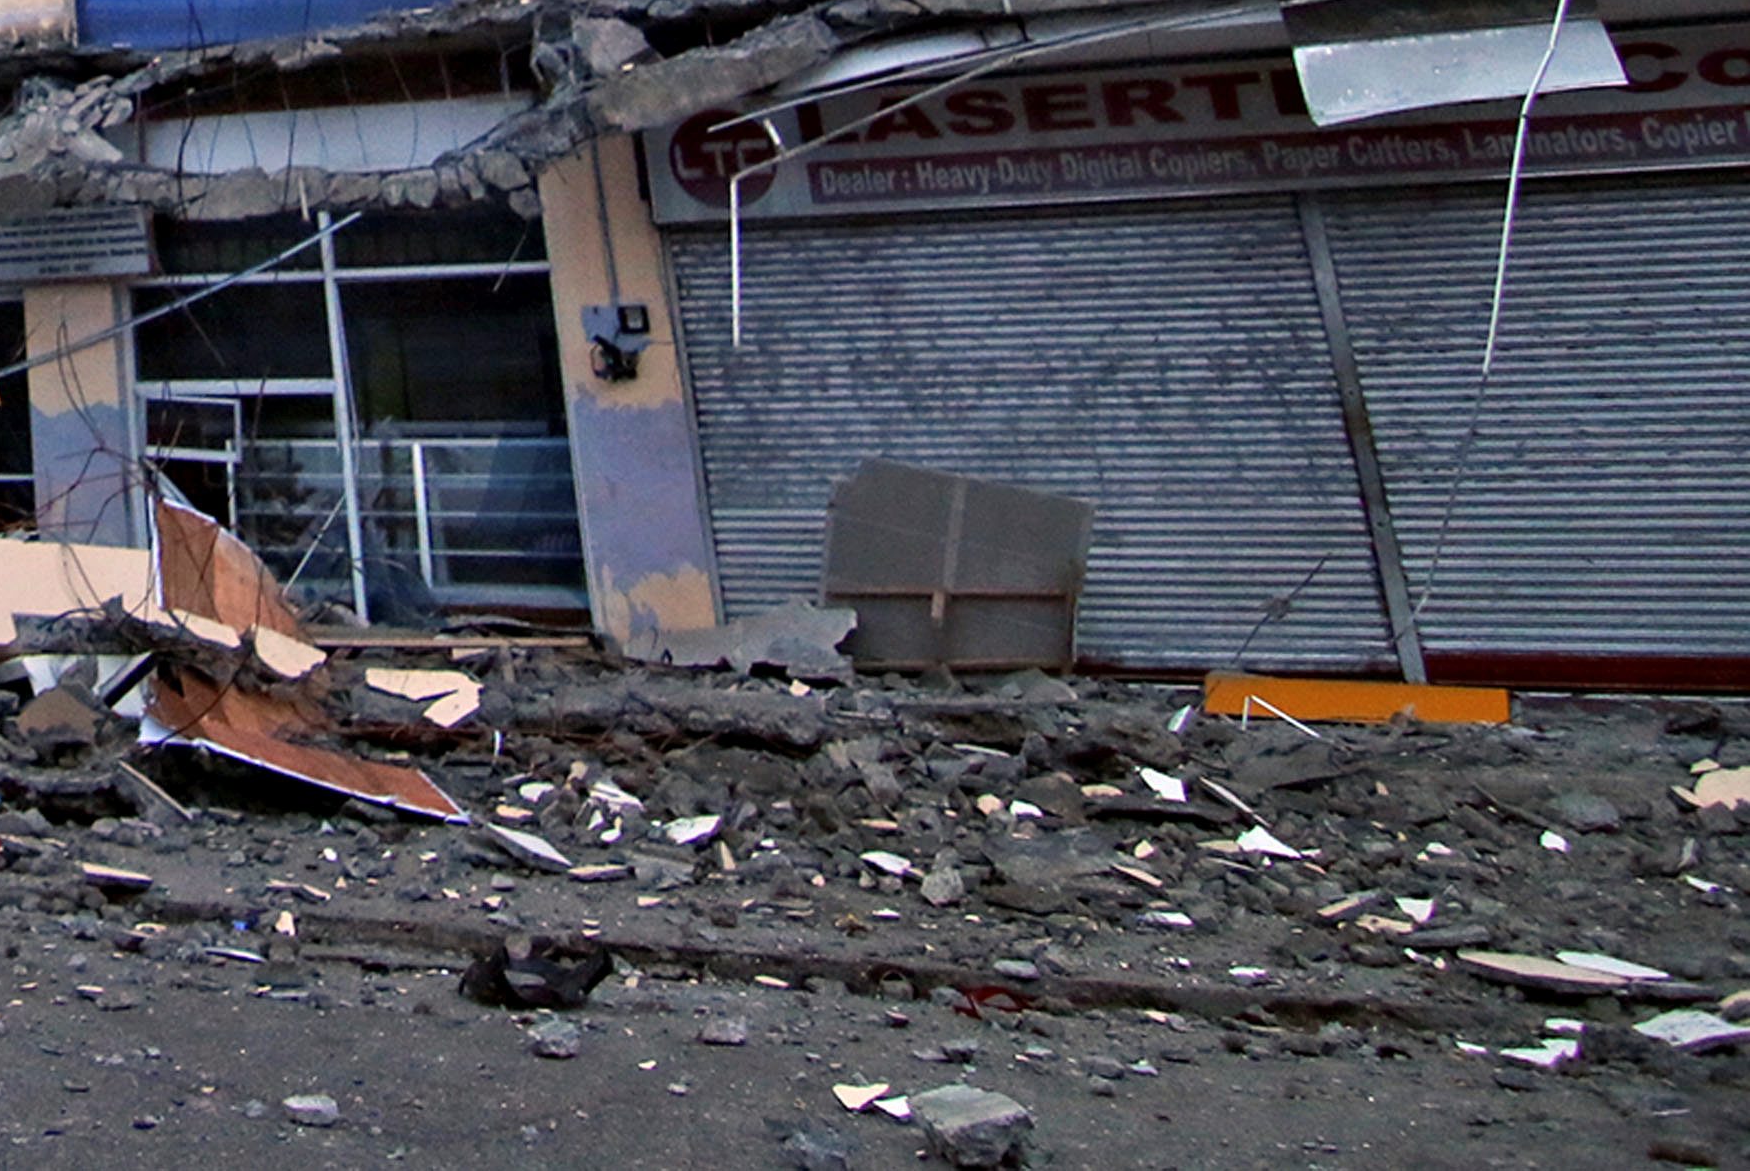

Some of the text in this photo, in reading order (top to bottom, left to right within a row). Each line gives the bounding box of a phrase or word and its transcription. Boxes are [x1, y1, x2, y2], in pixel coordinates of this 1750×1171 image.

[673, 137, 774, 180] LTC
[1059, 150, 1144, 187] Digital
[1151, 145, 1257, 182] Copiers,
[1261, 140, 1340, 175] Paper
[1348, 132, 1461, 168] Cutters,
[1640, 113, 1738, 155] Copier
